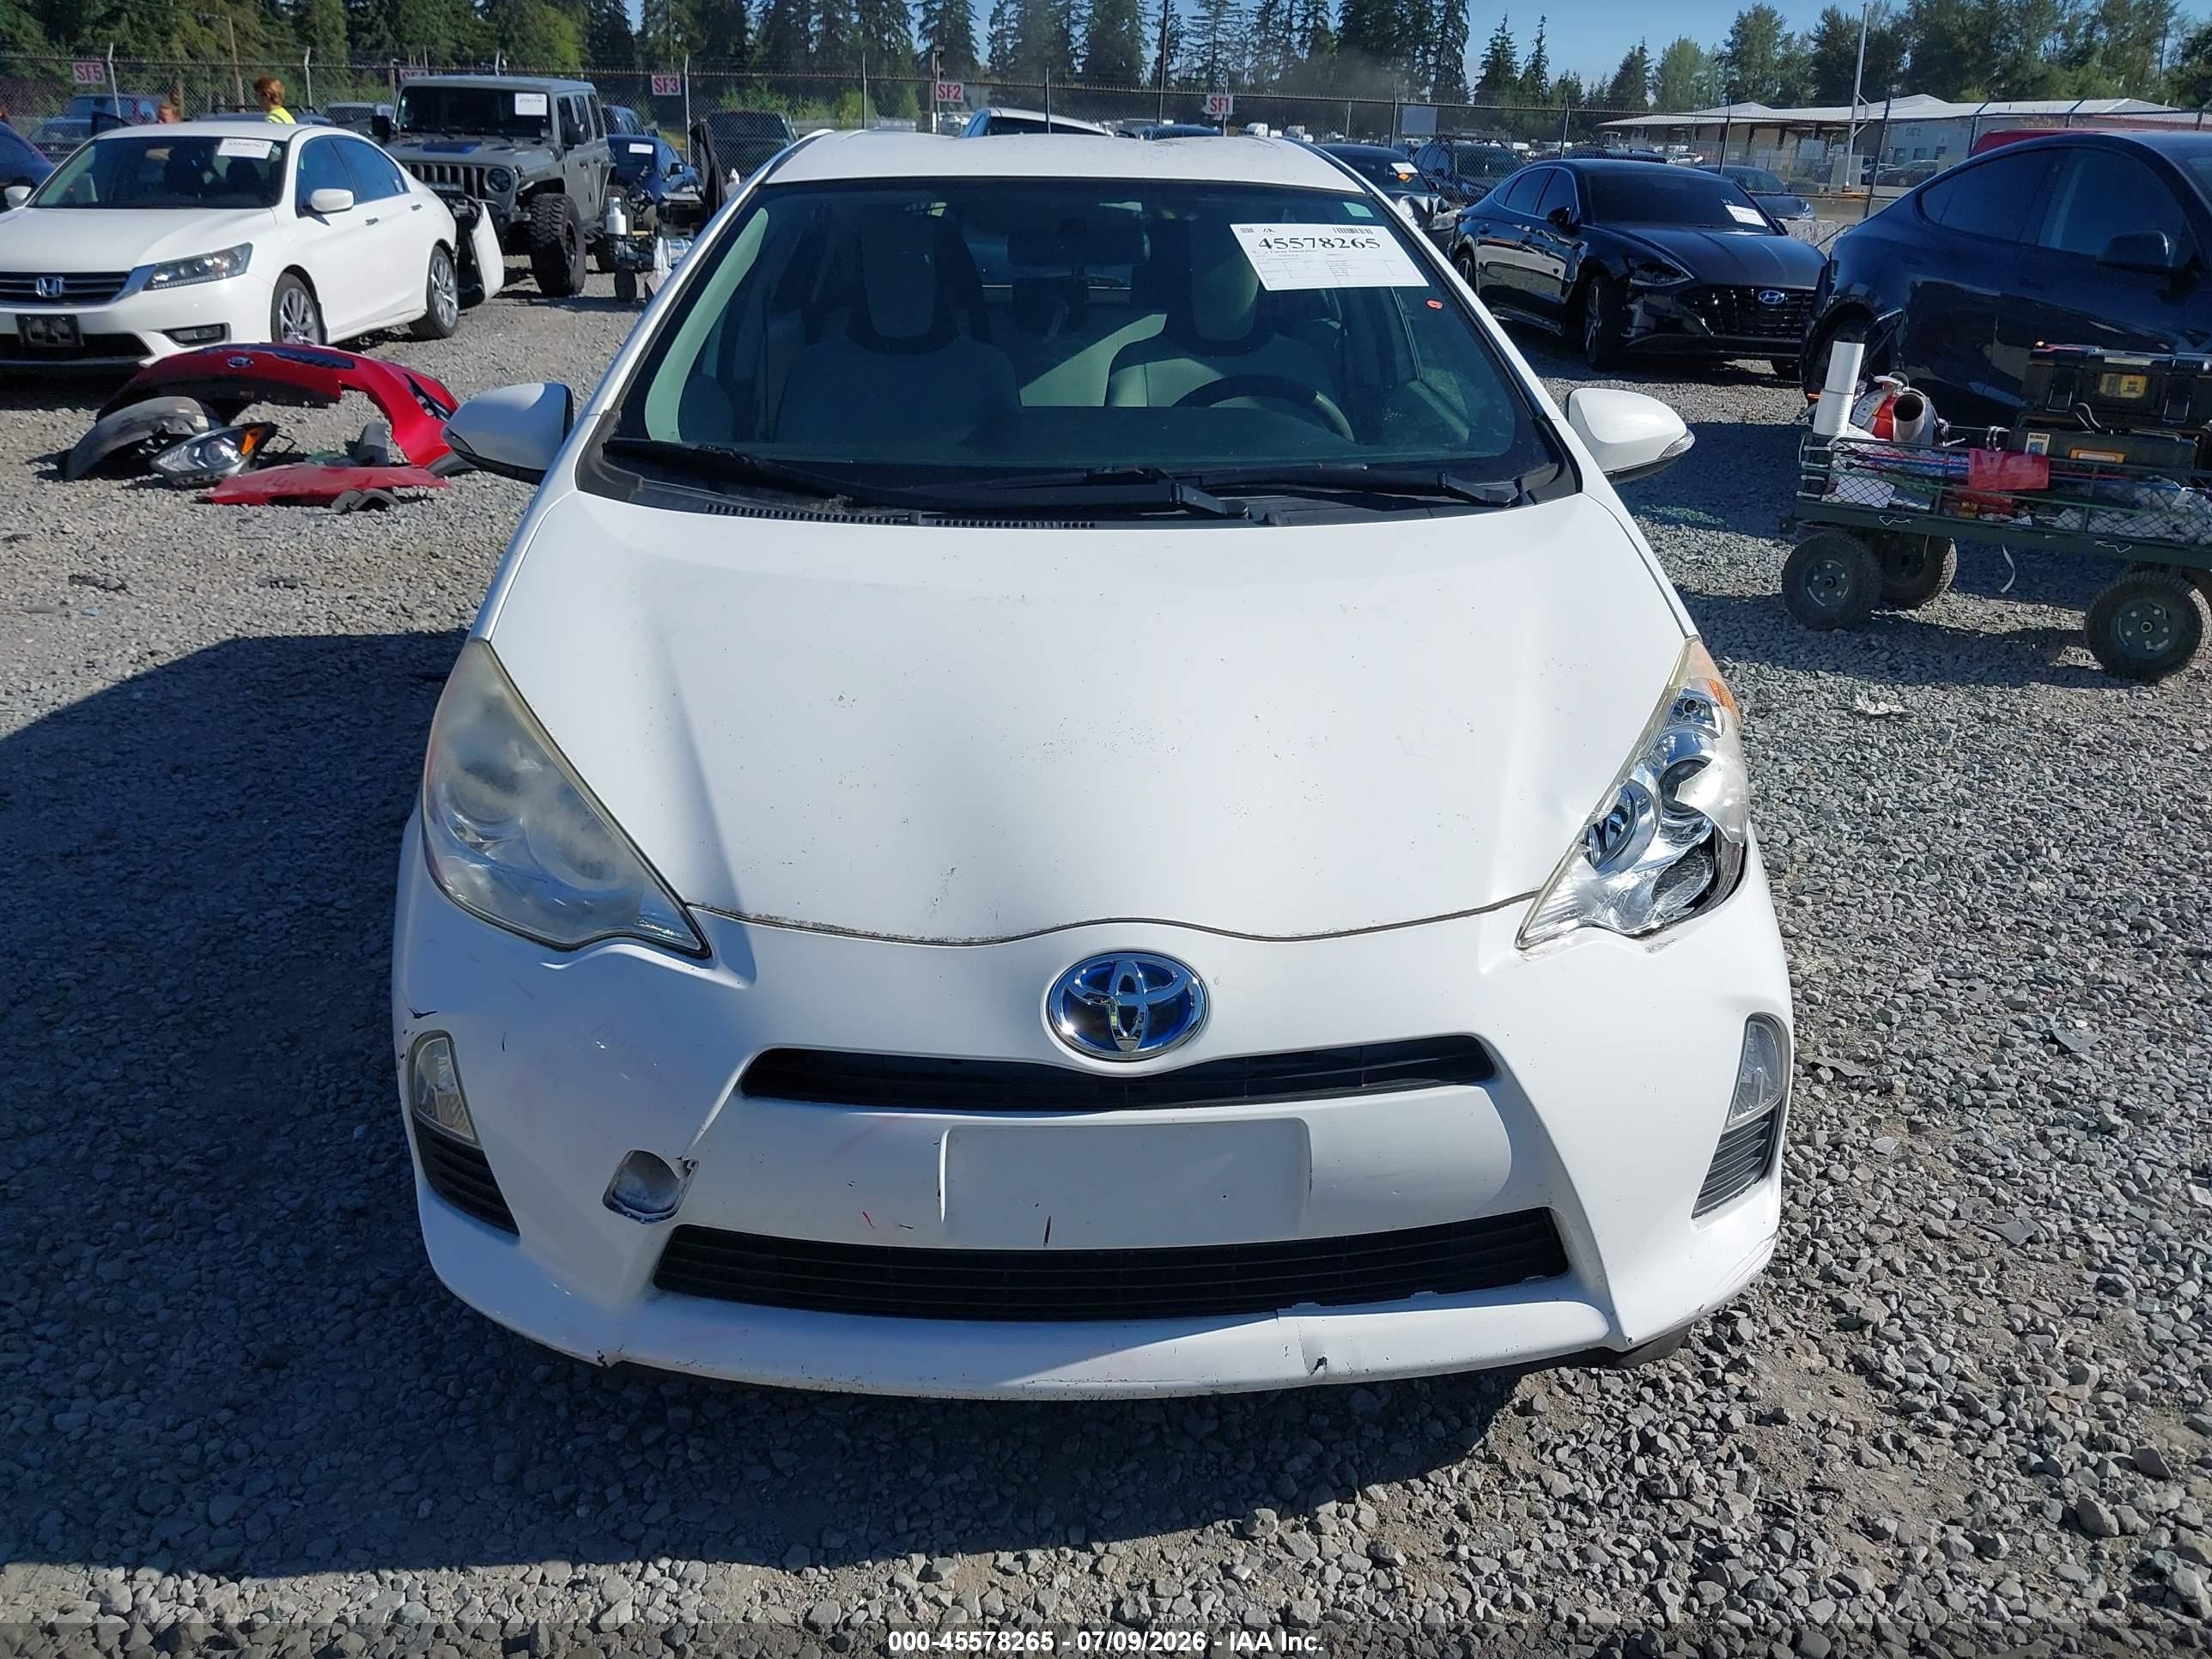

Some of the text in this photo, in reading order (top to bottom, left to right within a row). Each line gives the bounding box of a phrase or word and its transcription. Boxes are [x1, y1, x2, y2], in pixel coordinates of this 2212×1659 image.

[76, 64, 102, 82] SF5
[653, 77, 678, 94] SF3
[938, 83, 961, 100] SF2
[1210, 96, 1229, 112] SF1
[1258, 237, 1381, 250] 45578265
